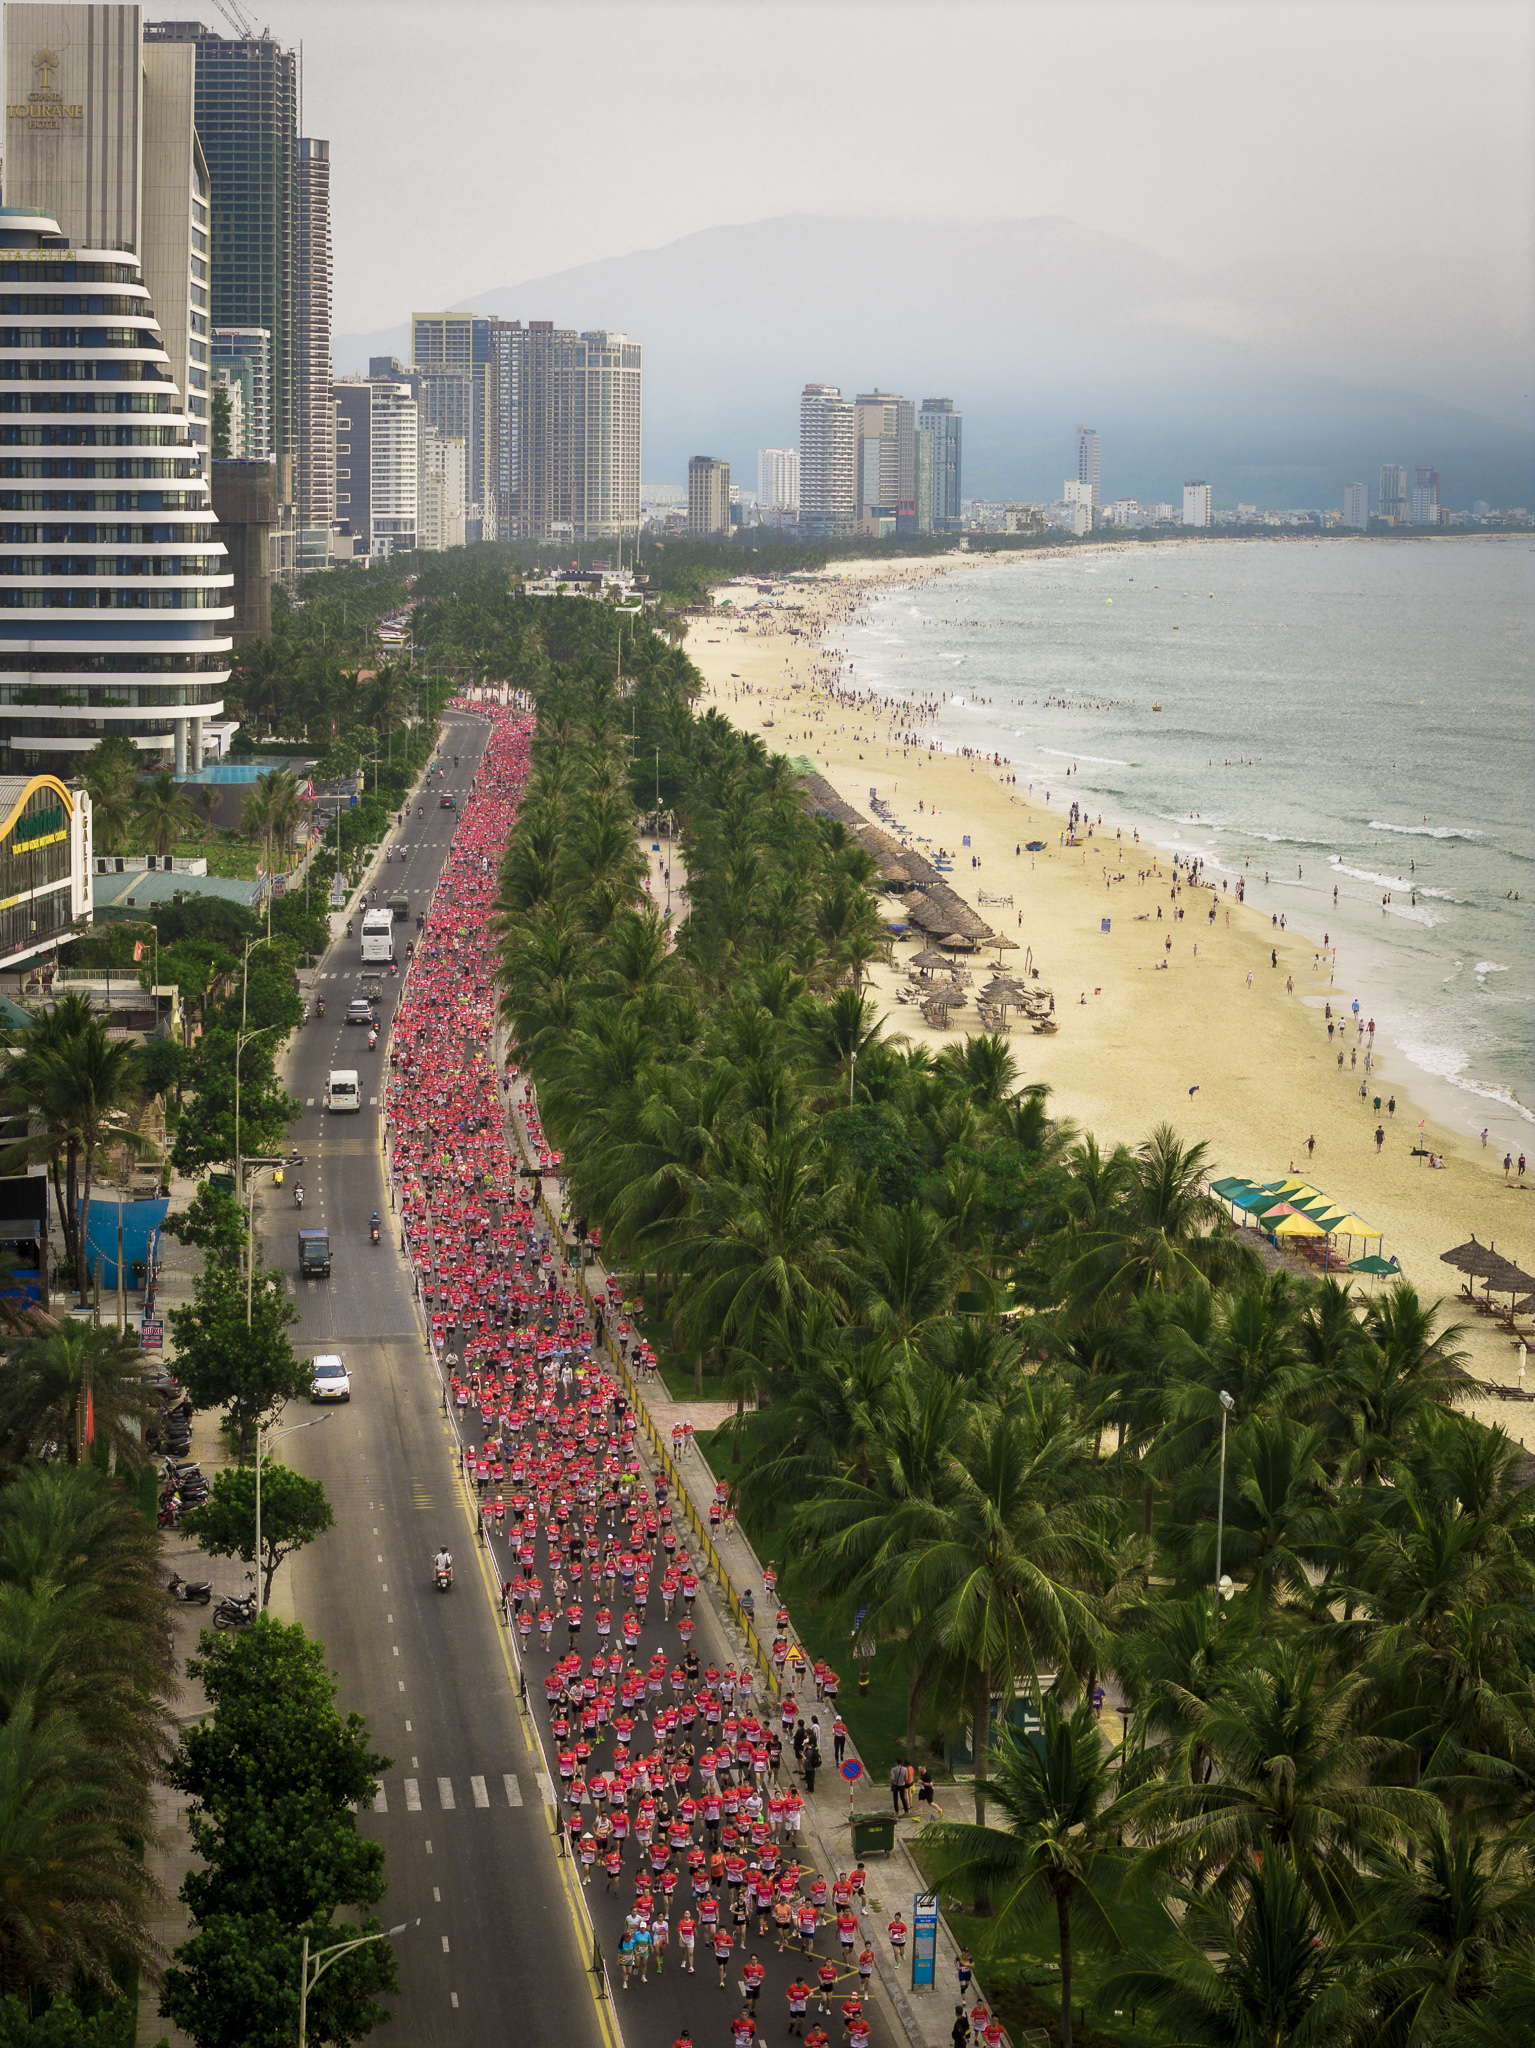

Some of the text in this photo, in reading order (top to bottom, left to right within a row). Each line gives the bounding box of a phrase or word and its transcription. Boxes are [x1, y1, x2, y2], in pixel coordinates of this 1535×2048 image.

[28, 93, 62, 102] GRAND
[7, 104, 84, 119] TOURANE
[28, 121, 61, 129] HOTEL
[27, 249, 76, 262] CELIA
[17, 804, 63, 839] Samarkand
[154, 1327, 163, 1335] XE
